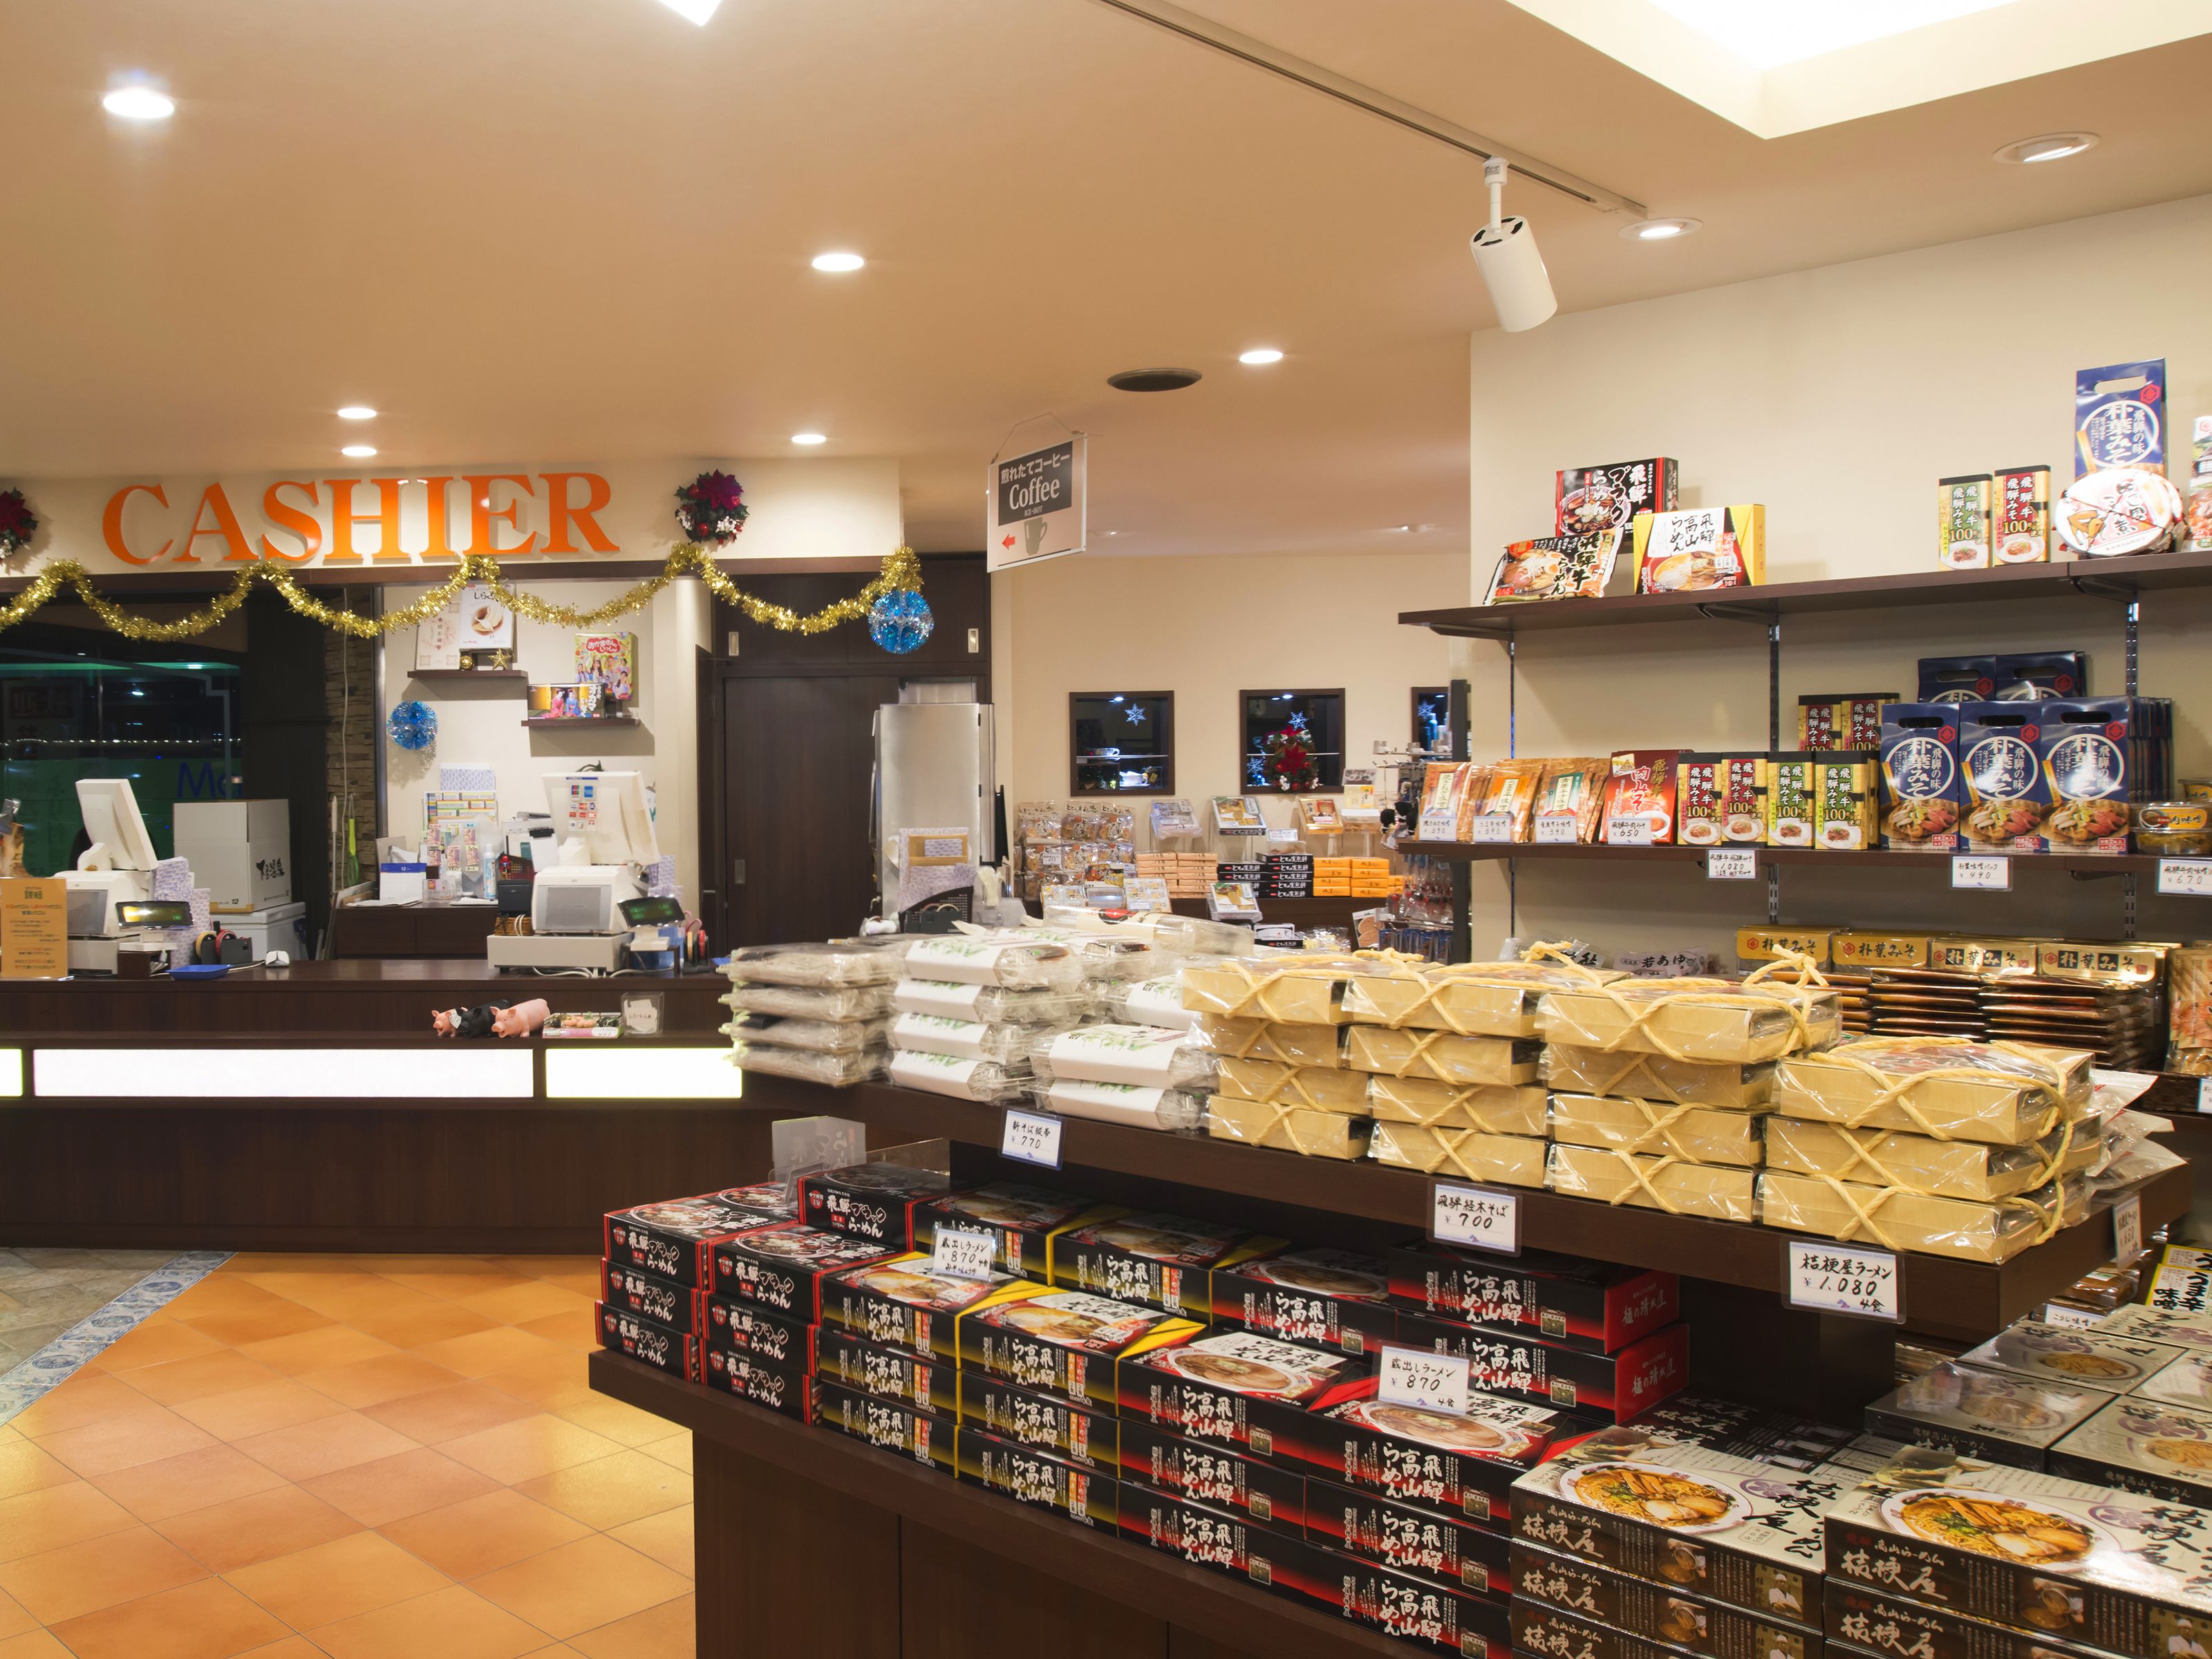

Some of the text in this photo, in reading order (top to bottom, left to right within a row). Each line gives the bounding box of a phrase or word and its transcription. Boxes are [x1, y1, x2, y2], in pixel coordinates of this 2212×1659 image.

[1001, 453, 1070, 484] 煎れたてコーヒー
[1009, 476, 1060, 510] Coffee
[1591, 470, 1609, 516] らーめん
[1609, 465, 1632, 525] ブラック
[102, 473, 620, 565] CASHIER
[1669, 516, 1685, 552] らーめん
[1685, 514, 1700, 547] 高山
[1631, 765, 1651, 812] 肉みそ
[1728, 802, 1756, 814] 100%
[1687, 806, 1716, 818] 100%
[1777, 806, 1807, 818] 100%
[1824, 808, 1855, 821] 100%
[1969, 871, 1991, 880] 490
[2177, 874, 2203, 885] 670
[1858, 942, 1918, 959] 朴葉みそ
[1945, 948, 2015, 968] 朴葉みそ
[2059, 950, 2134, 971] 朴葉みそ
[1021, 1136, 1041, 1149] 770
[848, 1217, 884, 1238] らーめん
[1459, 1213, 1493, 1229] 700
[940, 1236, 989, 1253] 蔵出しラーメン
[950, 1250, 976, 1264] 870
[647, 1257, 677, 1275] らーめん
[1106, 1254, 1123, 1301] らーめん
[1120, 1259, 1136, 1298] 高山
[1799, 1253, 1893, 1280] 桔梗屋ラーメン
[644, 1298, 673, 1321] らーめん
[757, 1287, 791, 1309] らーめん
[1274, 1292, 1293, 1341] らーめん
[1462, 1269, 1482, 1324] らーめん
[1481, 1275, 1502, 1321] 高山
[867, 1297, 881, 1343] らーめん
[879, 1302, 892, 1342] 高山
[1290, 1297, 1309, 1339] 高山
[637, 1342, 666, 1366] らーめん
[751, 1335, 785, 1360] らーめん
[1012, 1338, 1027, 1387] らーめん
[1025, 1343, 1041, 1385] 高山
[1391, 1356, 1458, 1378] 蔵出しラーメン
[1471, 1337, 1491, 1391] らーめん
[1490, 1342, 1512, 1388] 高山
[864, 1351, 878, 1395] らーめん
[876, 1356, 892, 1394] 高山
[1406, 1374, 1441, 1391] 870
[747, 1382, 782, 1408] らーめん
[1181, 1385, 1199, 1438] らーめん
[1197, 1390, 1216, 1436] 高山
[866, 1402, 881, 1446] らーめん
[879, 1407, 892, 1447] 高山
[1013, 1396, 1029, 1445] らーめん
[1027, 1402, 1043, 1444] 高山
[1011, 1454, 1027, 1502] らーめん
[1025, 1461, 1042, 1503] 高山
[1181, 1447, 1199, 1501] らーめん
[1197, 1453, 1216, 1499] 高山
[1382, 1441, 1402, 1499] らーめん
[1401, 1448, 1423, 1498] 高山
[1180, 1510, 1199, 1562] らーめん
[1522, 1513, 1604, 1559] 桔梗屋
[1548, 1505, 1602, 1529] 高山らーめん
[1197, 1517, 1215, 1562] 高山
[1380, 1510, 1401, 1567] らーめん
[1400, 1517, 1421, 1567] 高山
[1874, 1537, 1945, 1567] 高山らーめん
[1522, 1569, 1604, 1616] 桔梗屋
[1548, 1562, 1602, 1587] 高山らーめん
[1840, 1548, 1948, 1601] 桔梗屋
[1379, 1579, 1400, 1636] らーめん
[1398, 1587, 1421, 1637] 高山
[1873, 1603, 1944, 1633] 高山らーめん
[1523, 1624, 1604, 1659] 桔梗屋
[1548, 1616, 1602, 1643] 高山らーめん
[1839, 1612, 1936, 1659] 桔梗屋
